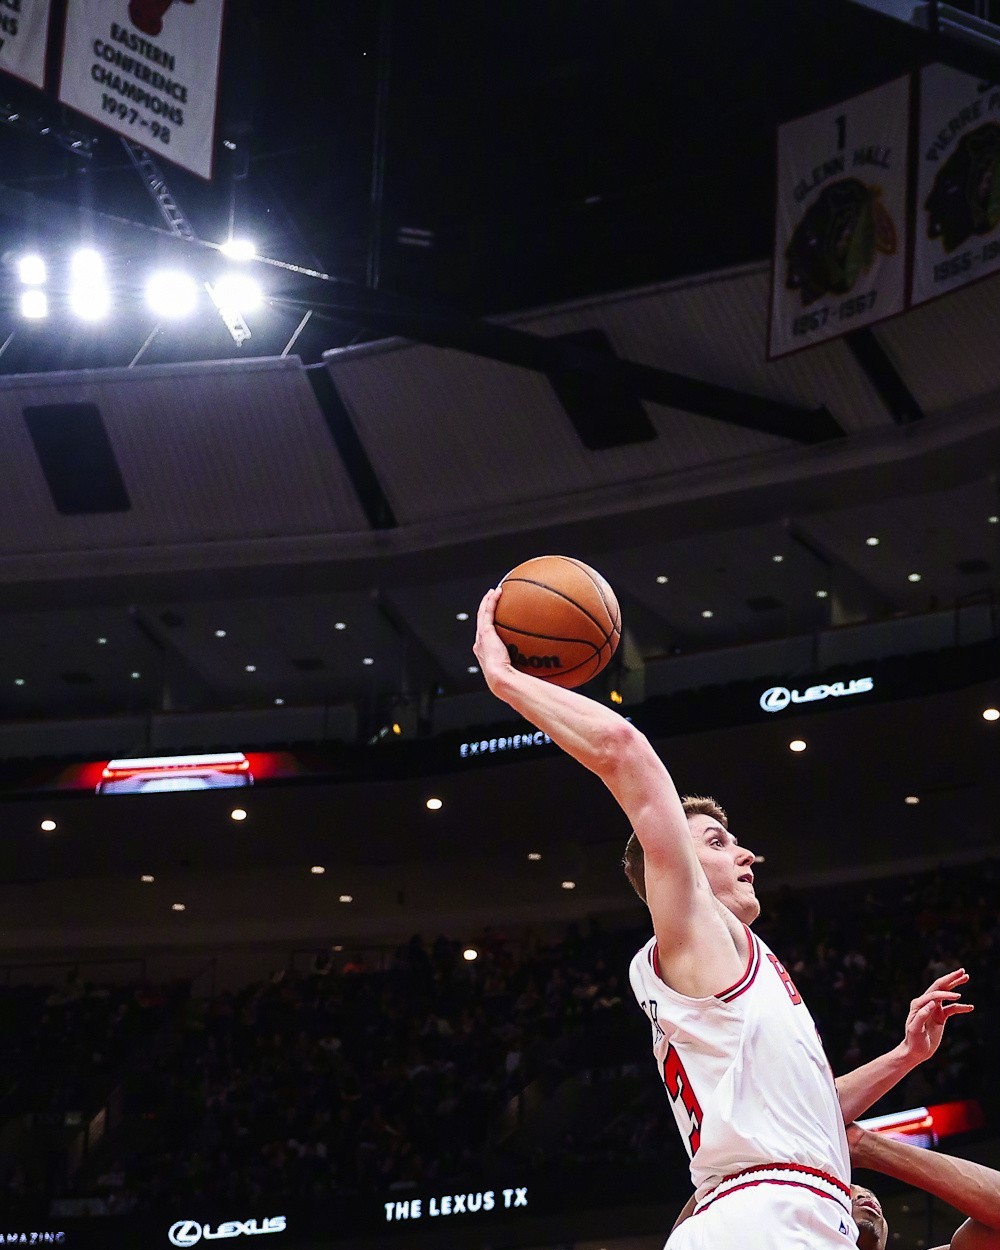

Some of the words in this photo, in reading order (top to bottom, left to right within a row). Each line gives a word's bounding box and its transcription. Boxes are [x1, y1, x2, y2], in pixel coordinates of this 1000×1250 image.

[92, 38, 188, 104] CONFERENCE
[110, 22, 176, 72] EASTERN
[90, 63, 184, 126] CHAMPIONS
[101, 92, 171, 145] 1997-98
[790, 677, 874, 704] LEXUS
[202, 1215, 287, 1240] LEXUS
[384, 1200, 422, 1222] THE
[429, 1190, 495, 1217] LEXUS
[502, 1187, 528, 1208] TX
